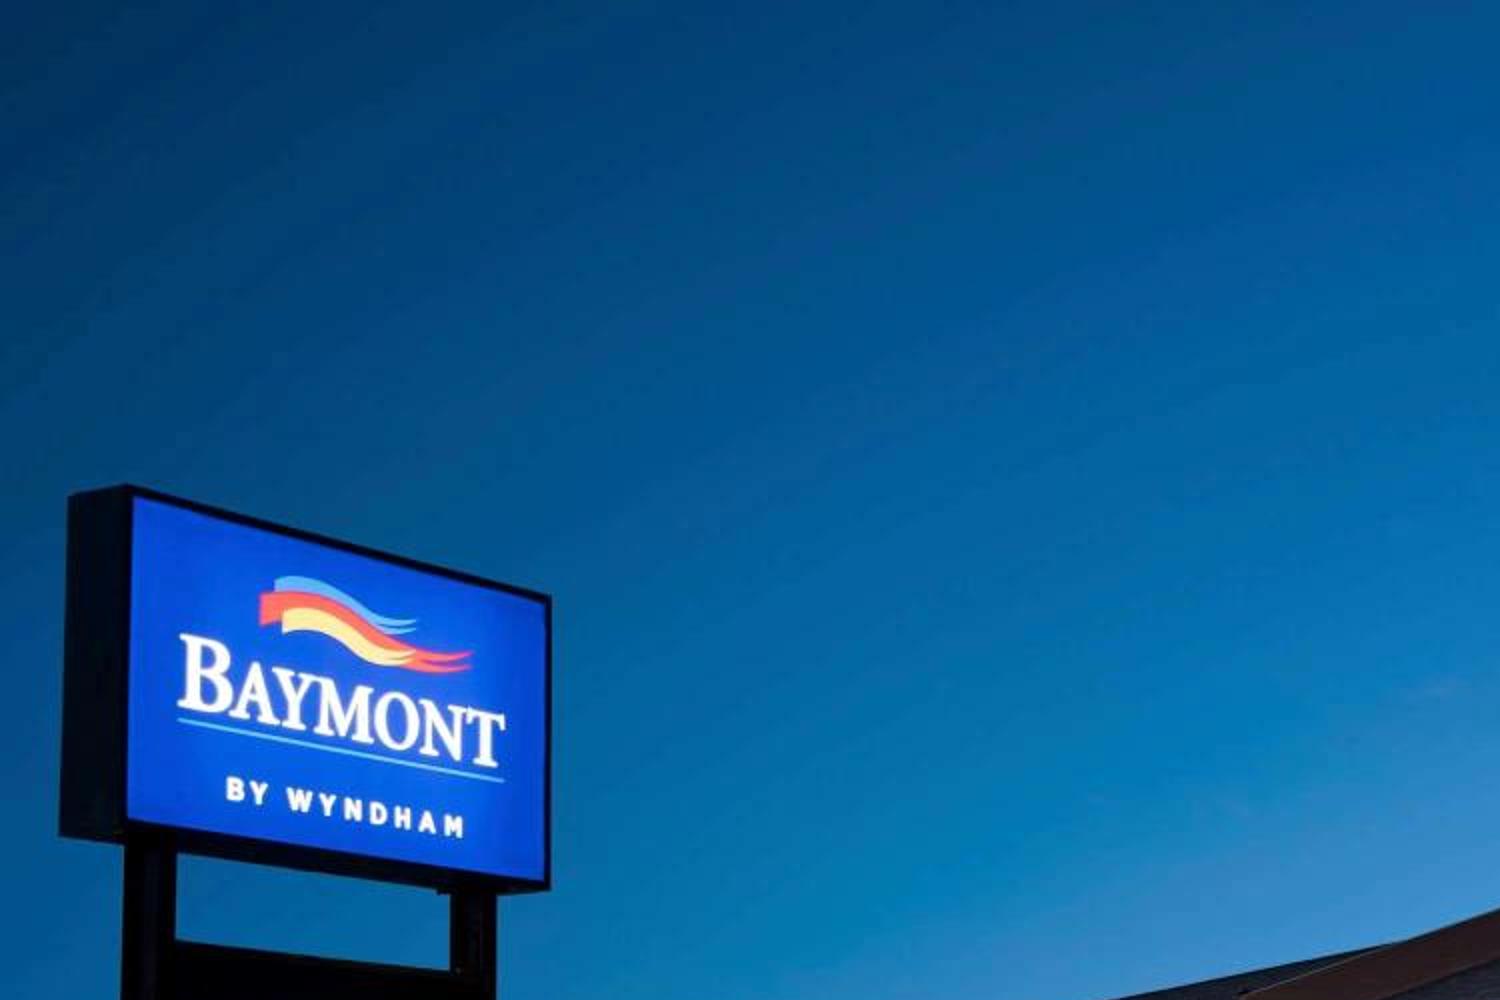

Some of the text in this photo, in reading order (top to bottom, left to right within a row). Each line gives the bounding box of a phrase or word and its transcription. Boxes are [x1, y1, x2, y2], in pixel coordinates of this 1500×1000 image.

[178, 633, 505, 768] BAYMONT
[227, 777, 464, 838] BY WYNDHAM
